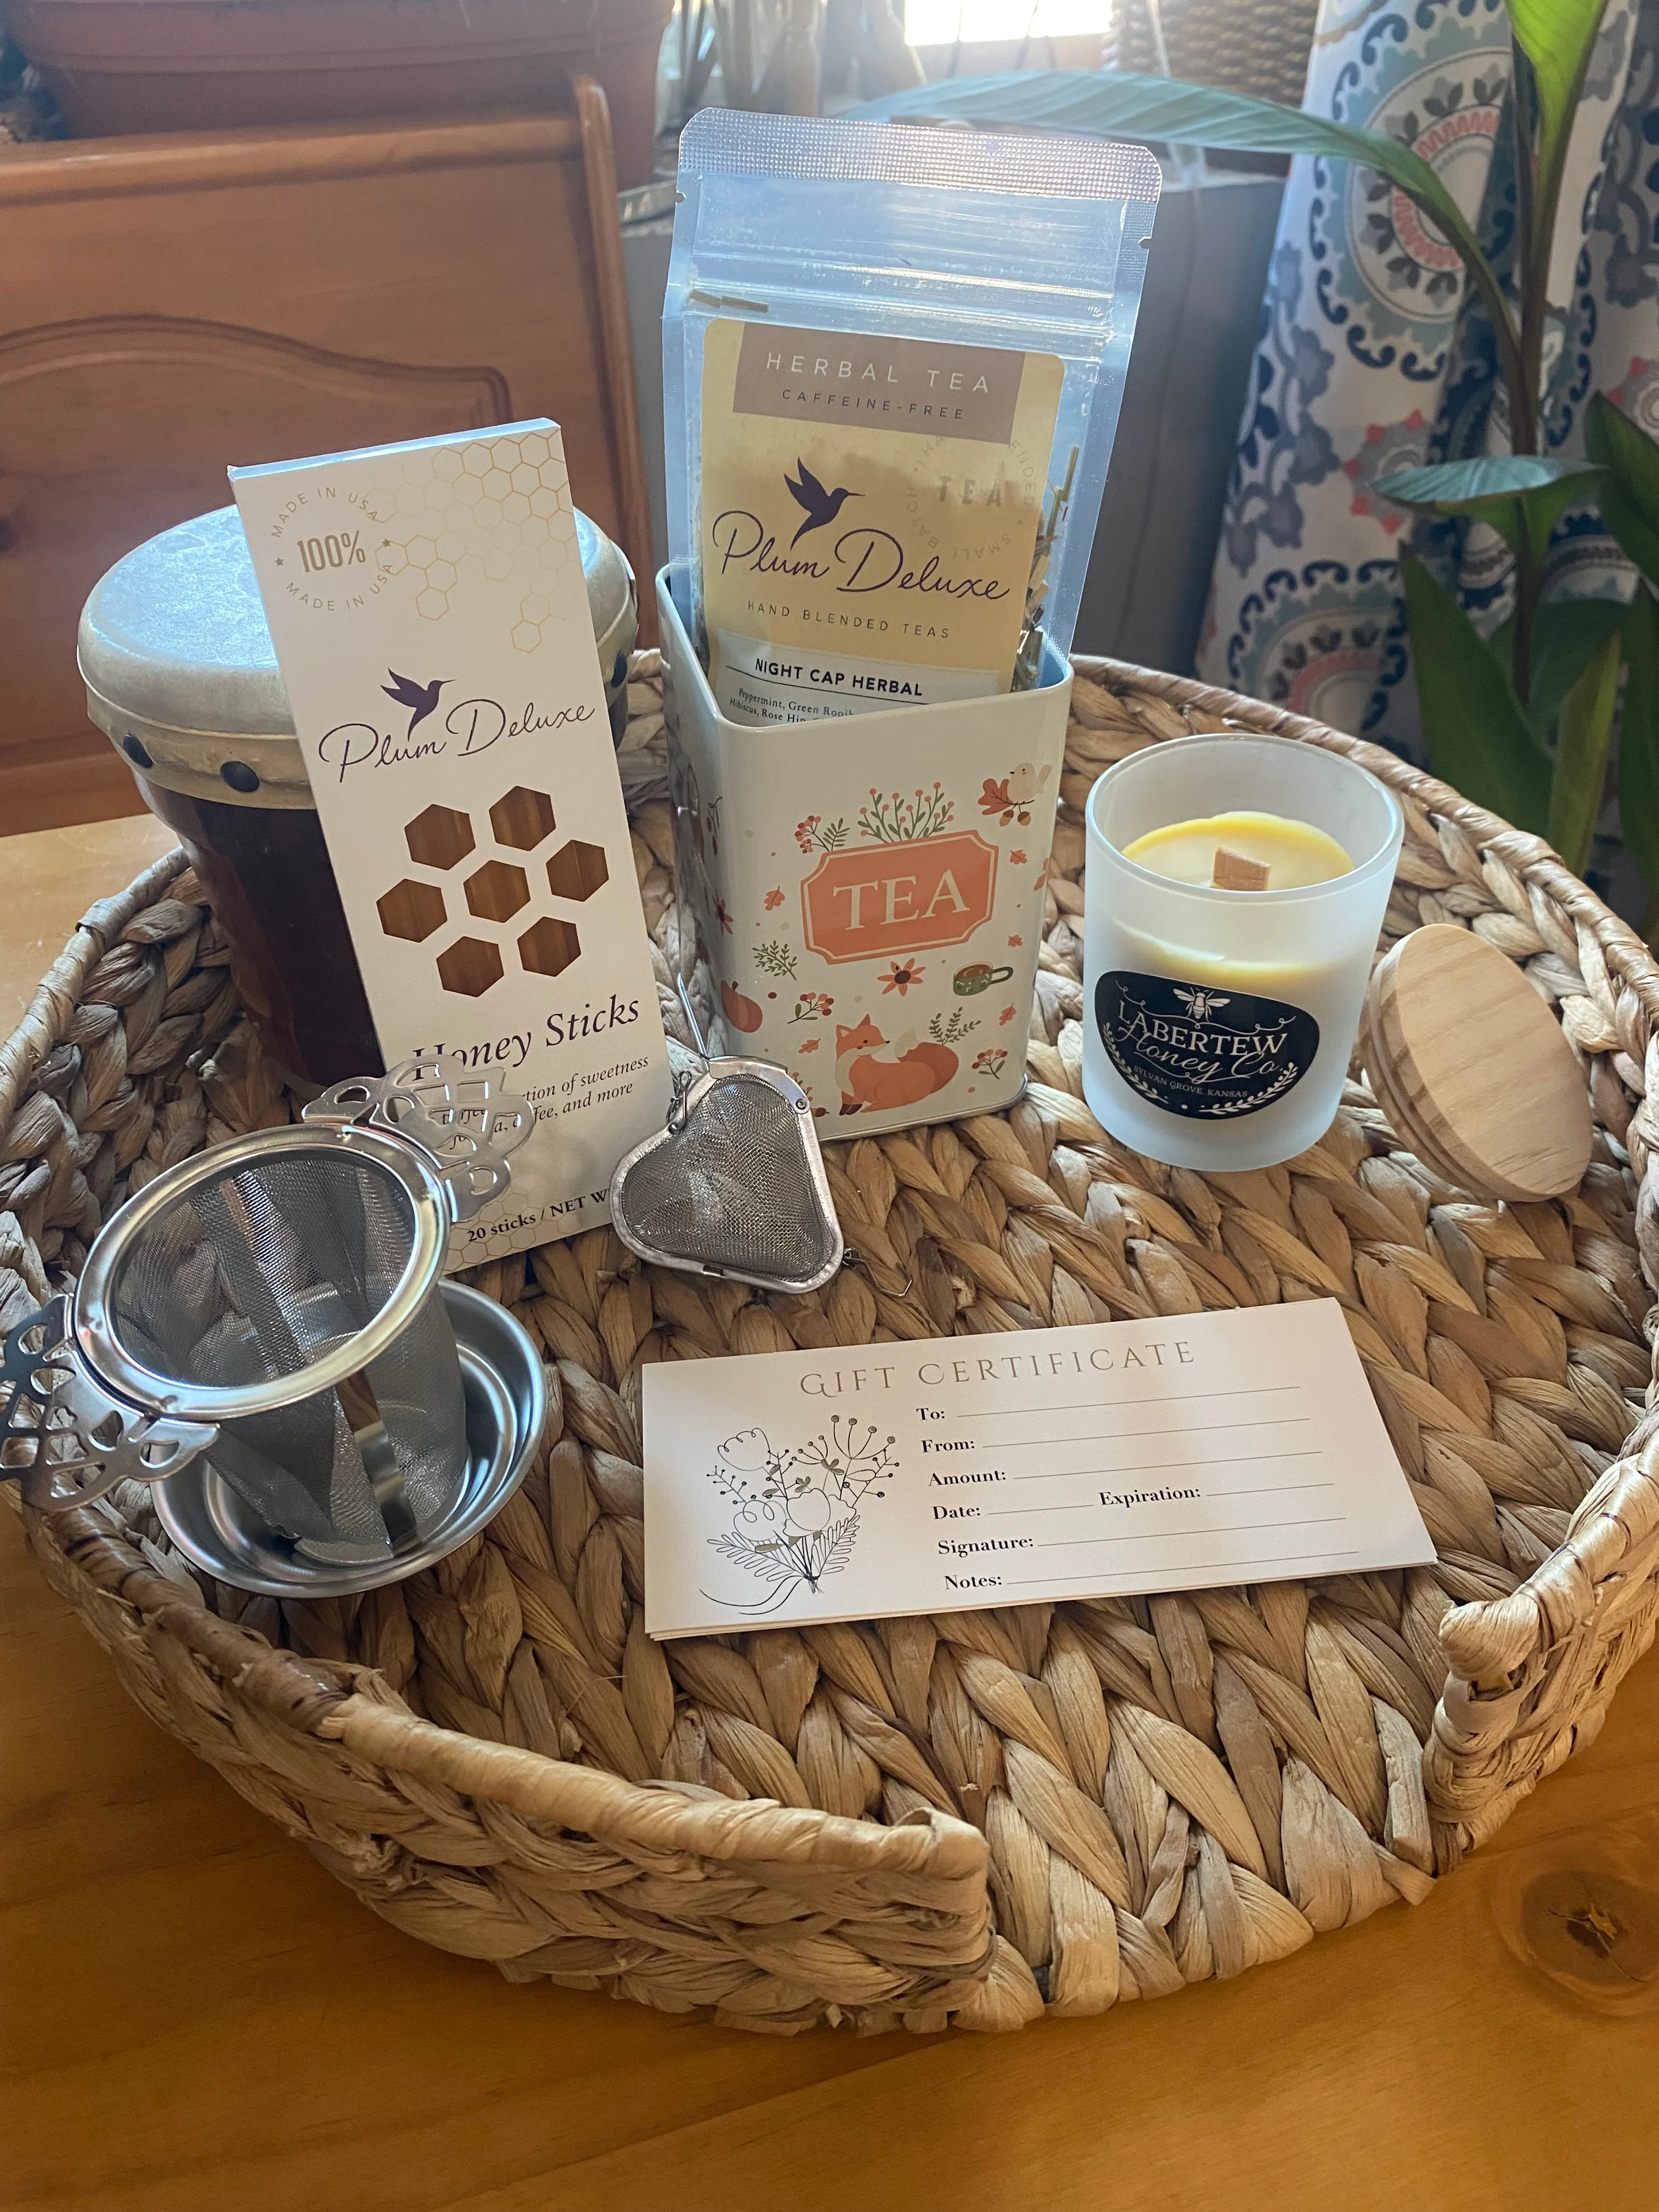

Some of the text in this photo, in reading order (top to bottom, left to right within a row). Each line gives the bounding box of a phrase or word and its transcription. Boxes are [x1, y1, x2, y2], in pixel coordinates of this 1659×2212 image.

[766, 352, 989, 393] HERBAL TEA
[782, 389, 964, 420] CAFFEINE-FREE
[271, 487, 379, 538] MADE IN USA
[297, 530, 366, 573] 100%
[712, 510, 1011, 600] Plum Deluxe
[286, 564, 393, 611] MADE IN USA
[748, 600, 949, 639] HAND BLENDED TEAS
[755, 657, 923, 697] NIGHT CAP HERBAL
[730, 697, 759, 717] Hibiscus,
[761, 708, 783, 721] Rose
[738, 688, 786, 710] Peppermint,
[788, 701, 819, 714] Green
[318, 698, 596, 783] Plum Deluxe
[833, 868, 970, 930] TEA
[546, 994, 640, 1048] Sticks
[1118, 1000, 1288, 1056] LABERTEW
[1111, 1025, 1223, 1085] Honey
[561, 1074, 579, 1099] of
[580, 1056, 650, 1088] sweetness
[562, 1093, 592, 1114] and
[596, 1081, 634, 1103] more
[1133, 1065, 1167, 1085] SYLVAN
[1207, 1088, 1248, 1098] KANSAS
[467, 1227, 486, 1242] 20
[490, 1214, 537, 1235] sticks
[549, 1195, 586, 1217] NET
[590, 1188, 610, 1203] W
[800, 1340, 1196, 1398] GIFT CERTIFICATE
[916, 1407, 946, 1421] To:
[921, 1439, 975, 1454] From:
[928, 1470, 1007, 1487] Amount:
[932, 1486, 1202, 1520] Date: Expiration:
[938, 1537, 1034, 1558] Signature:
[943, 1575, 1003, 1590] Notes:
